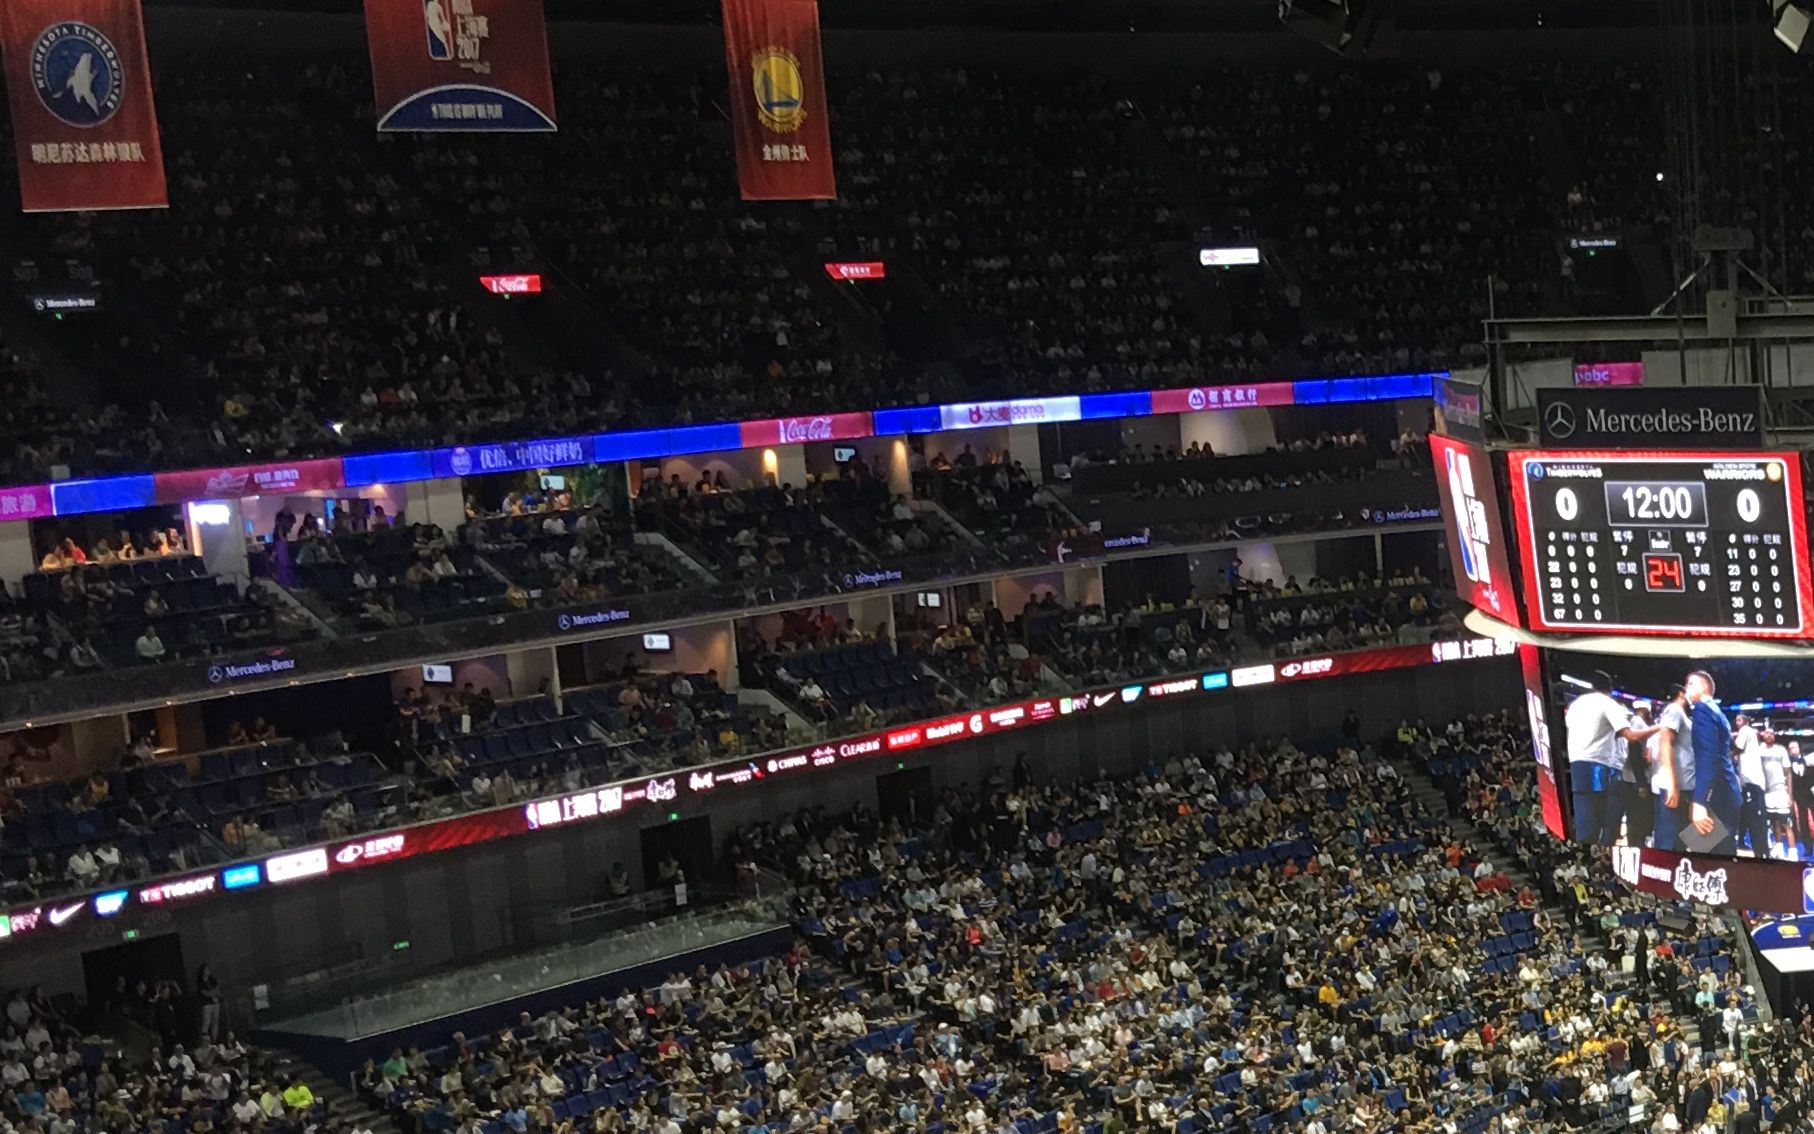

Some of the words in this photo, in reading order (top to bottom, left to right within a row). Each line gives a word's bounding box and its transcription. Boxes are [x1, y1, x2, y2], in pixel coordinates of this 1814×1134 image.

[1586, 407, 1756, 433] Mercedes-Benz
[1555, 487, 1578, 520] 0
[1622, 486, 1692, 519] 12:00
[1737, 488, 1761, 522] 0
[1648, 558, 1680, 587] 24
[572, 609, 630, 627] Mercedes-Benz
[225, 658, 295, 678] Mercedes-Benz
